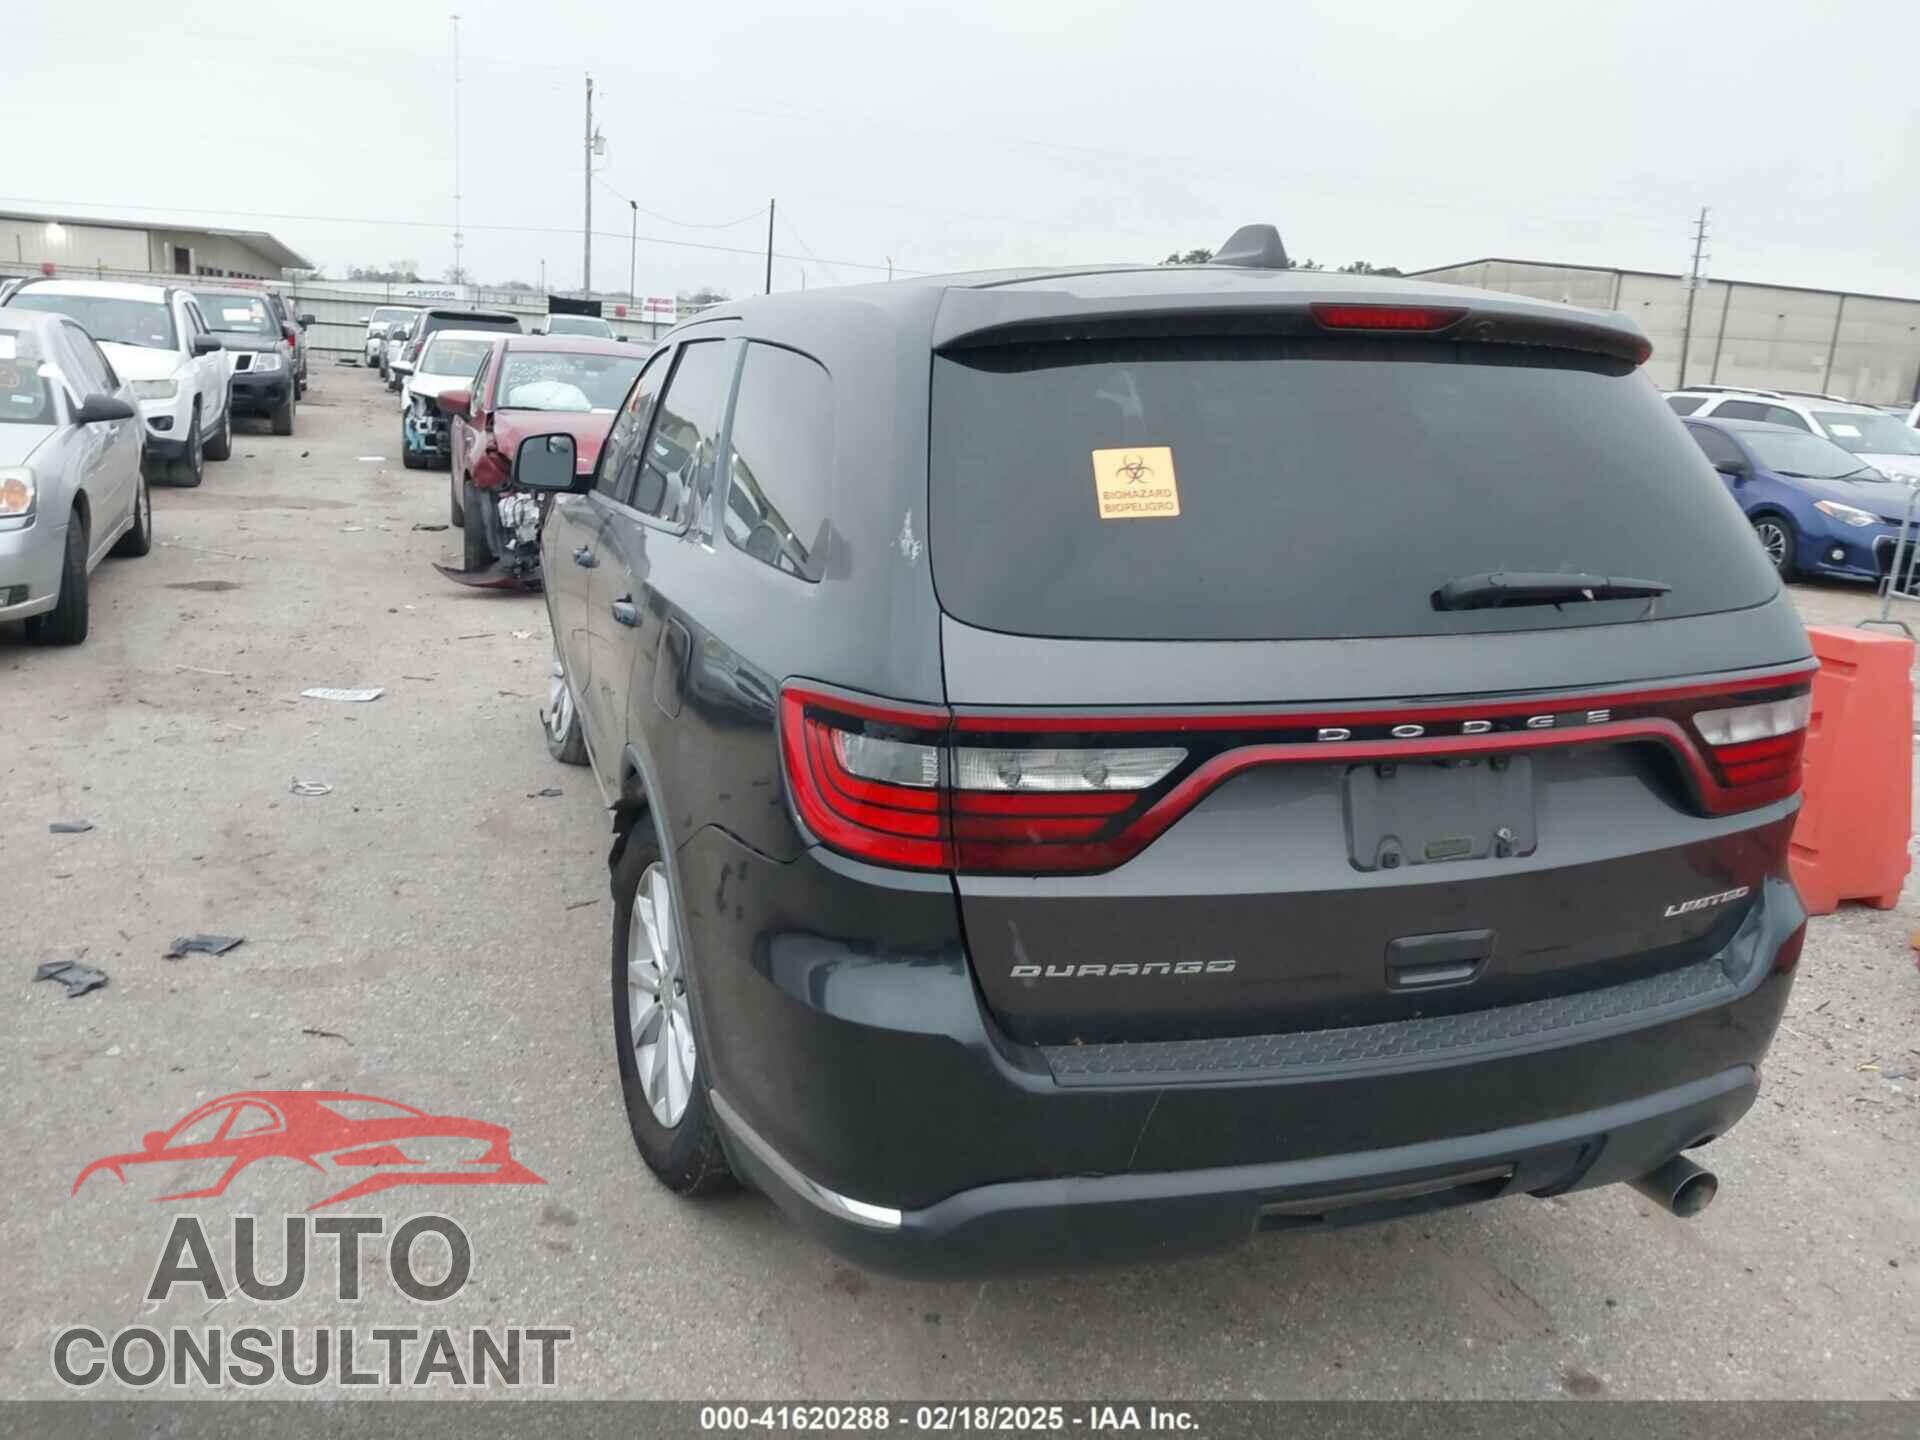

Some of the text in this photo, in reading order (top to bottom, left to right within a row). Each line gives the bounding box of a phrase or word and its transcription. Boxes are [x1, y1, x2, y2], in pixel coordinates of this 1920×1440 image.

[1103, 489, 1172, 500] BIOHAZARD
[1104, 501, 1175, 513] BIOPELIGRO
[1317, 709, 1611, 742] DODGE
[1010, 960, 1237, 977] DURANGO
